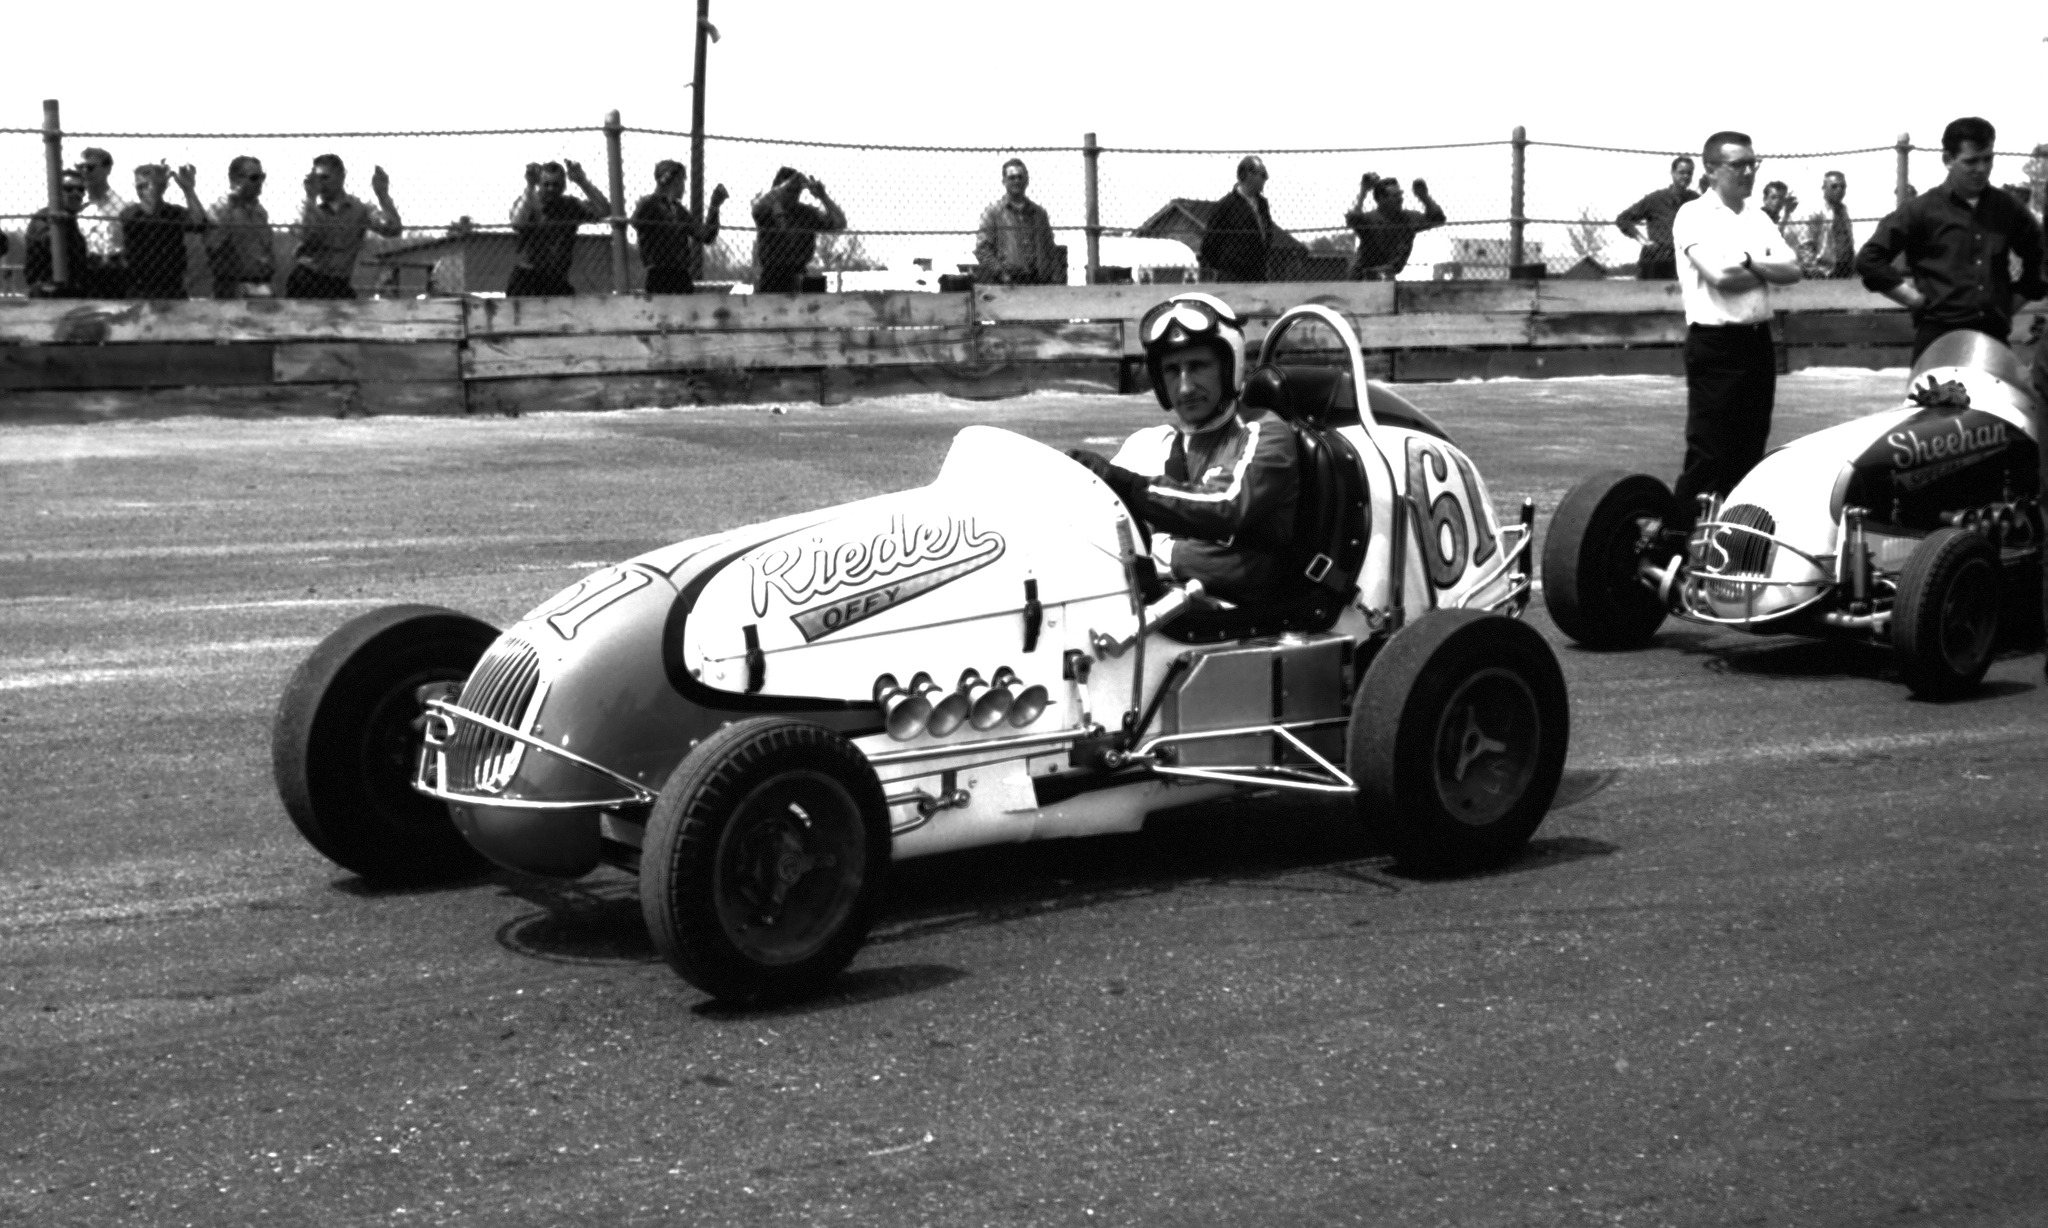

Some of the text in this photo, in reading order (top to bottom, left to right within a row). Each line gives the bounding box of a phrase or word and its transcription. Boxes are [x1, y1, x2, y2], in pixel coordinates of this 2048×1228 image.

[1887, 418, 2008, 469] Sheehan
[1405, 436, 1498, 591] 61
[742, 512, 1006, 618] Rieder
[821, 585, 903, 631] OFFY
